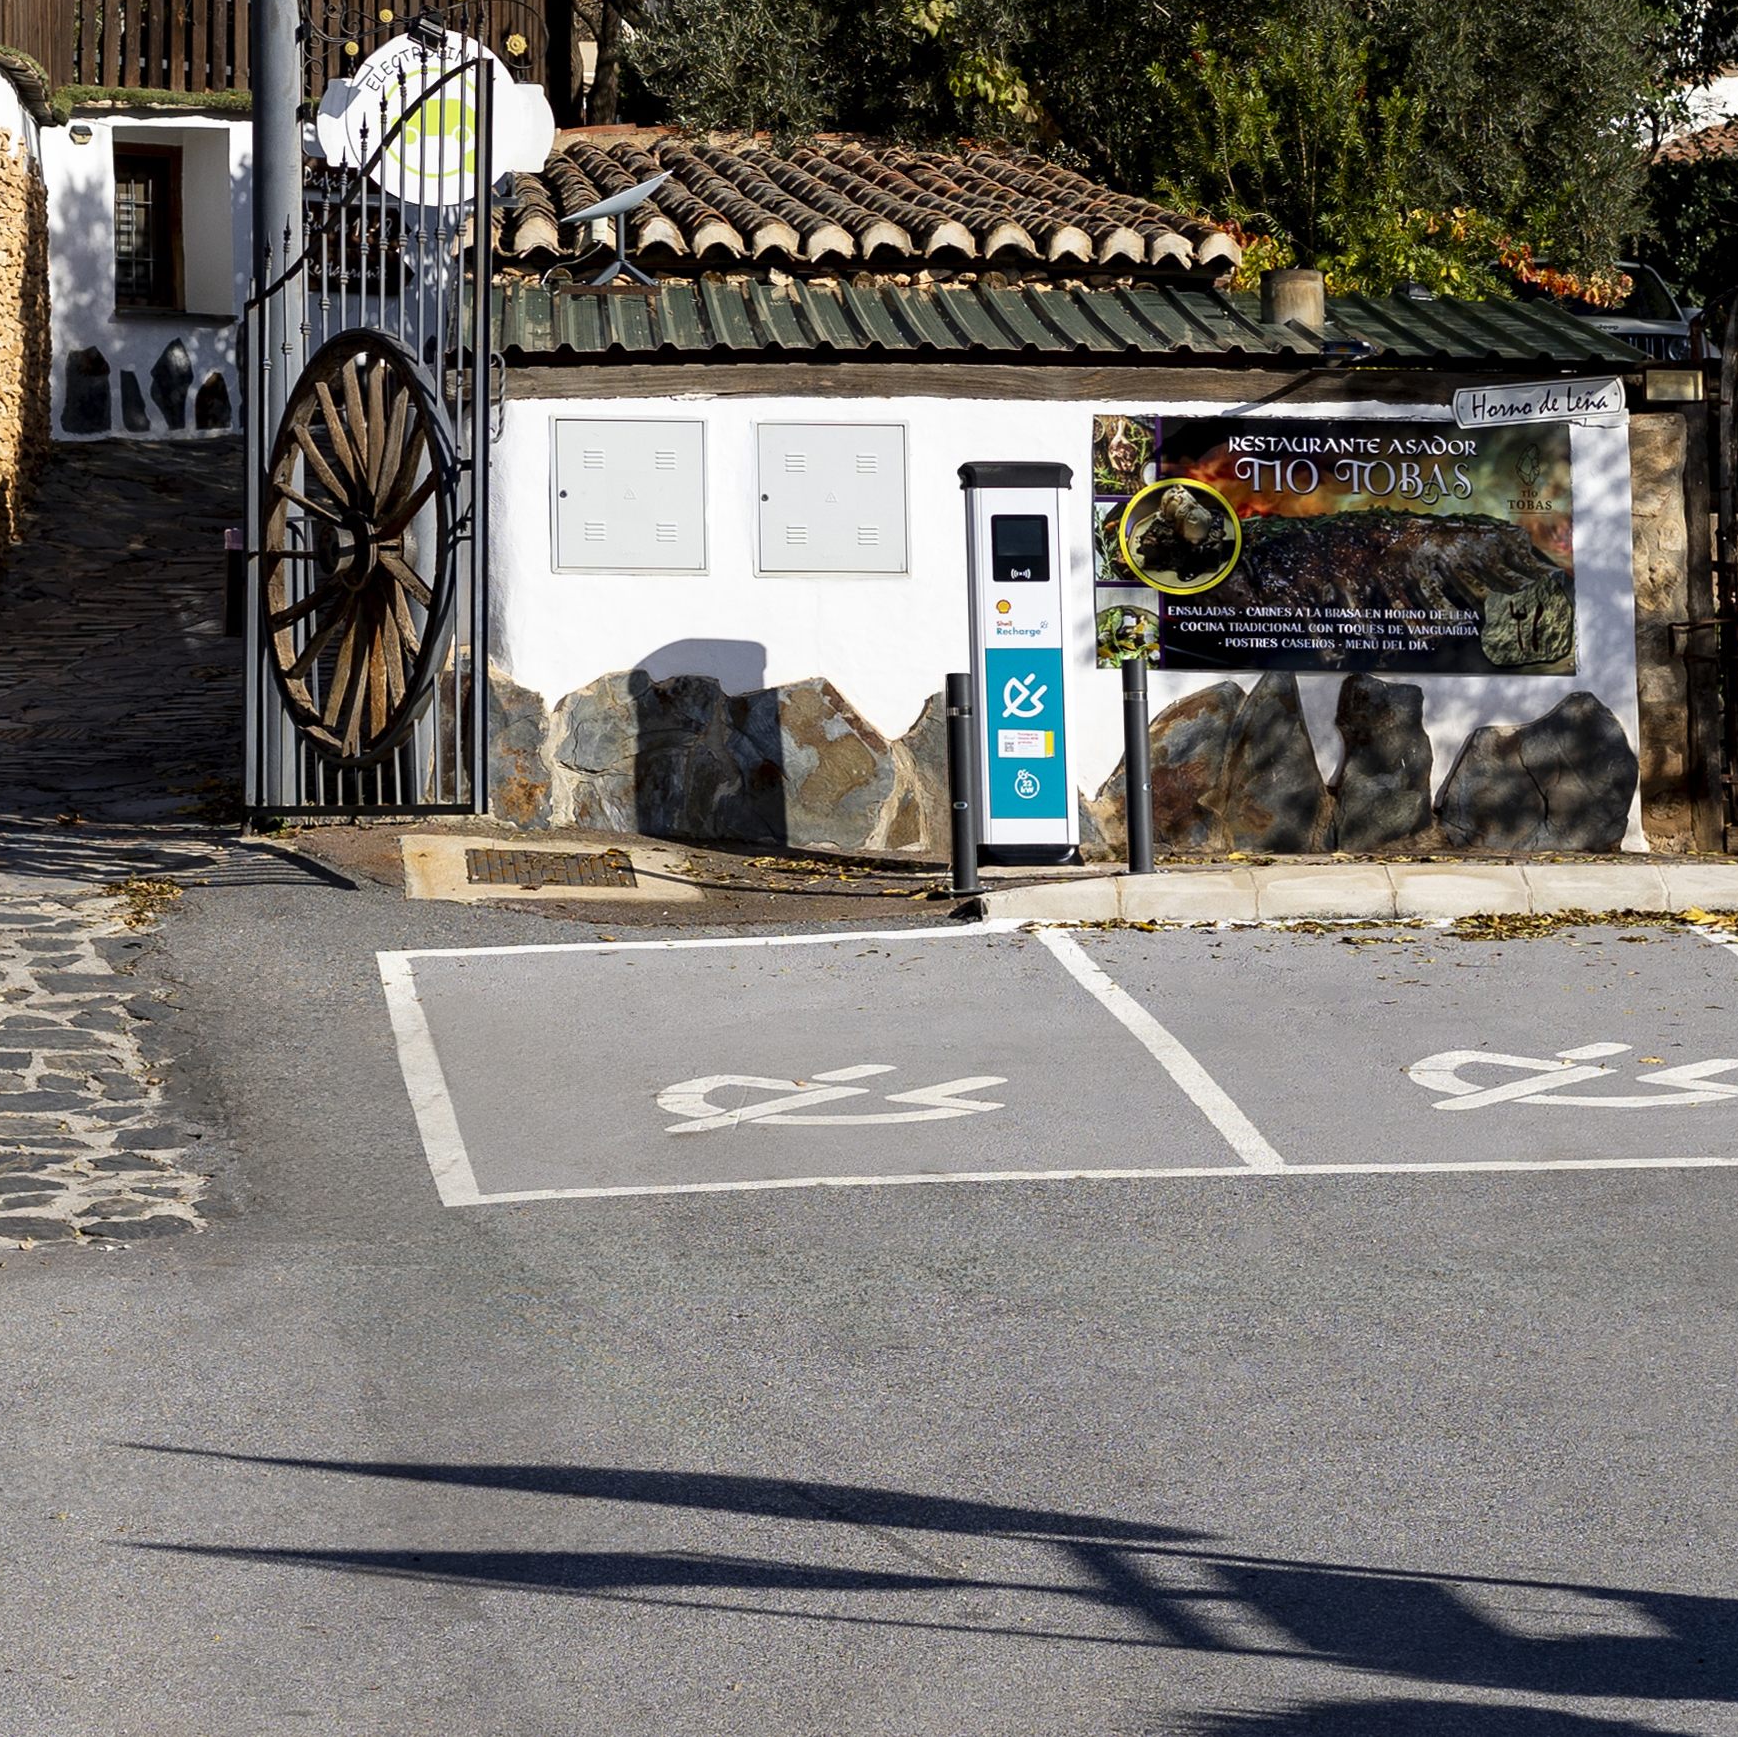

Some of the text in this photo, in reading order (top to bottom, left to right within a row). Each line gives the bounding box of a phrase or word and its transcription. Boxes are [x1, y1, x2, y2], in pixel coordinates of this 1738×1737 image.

[1472, 386, 1609, 420] Horno de Leña
[1228, 435, 1478, 457] RESTAURANTE ASADOR
[1235, 456, 1474, 505] TIO TOBAS
[1507, 499, 1553, 511] TOBAS
[1167, 605, 1236, 617] ENSALADAS
[1246, 606, 1292, 617] CARNES
[1295, 607, 1304, 618] A
[1307, 607, 1321, 618] LA
[1325, 607, 1363, 619] BRASA
[1365, 608, 1382, 619] EN
[1384, 609, 1426, 620] HORNO
[1430, 609, 1446, 620] DE
[996, 626, 1041, 637] Recharge
[1180, 621, 1226, 632] COCINA
[1227, 622, 1306, 633] TRADICIONAL
[1308, 623, 1334, 633] CON
[1388, 624, 1404, 634] DE
[1407, 625, 1480, 636] VANGUARDIA
[1225, 637, 1429, 651] POSTRES CASEROS MENÚ DEL DÍA
